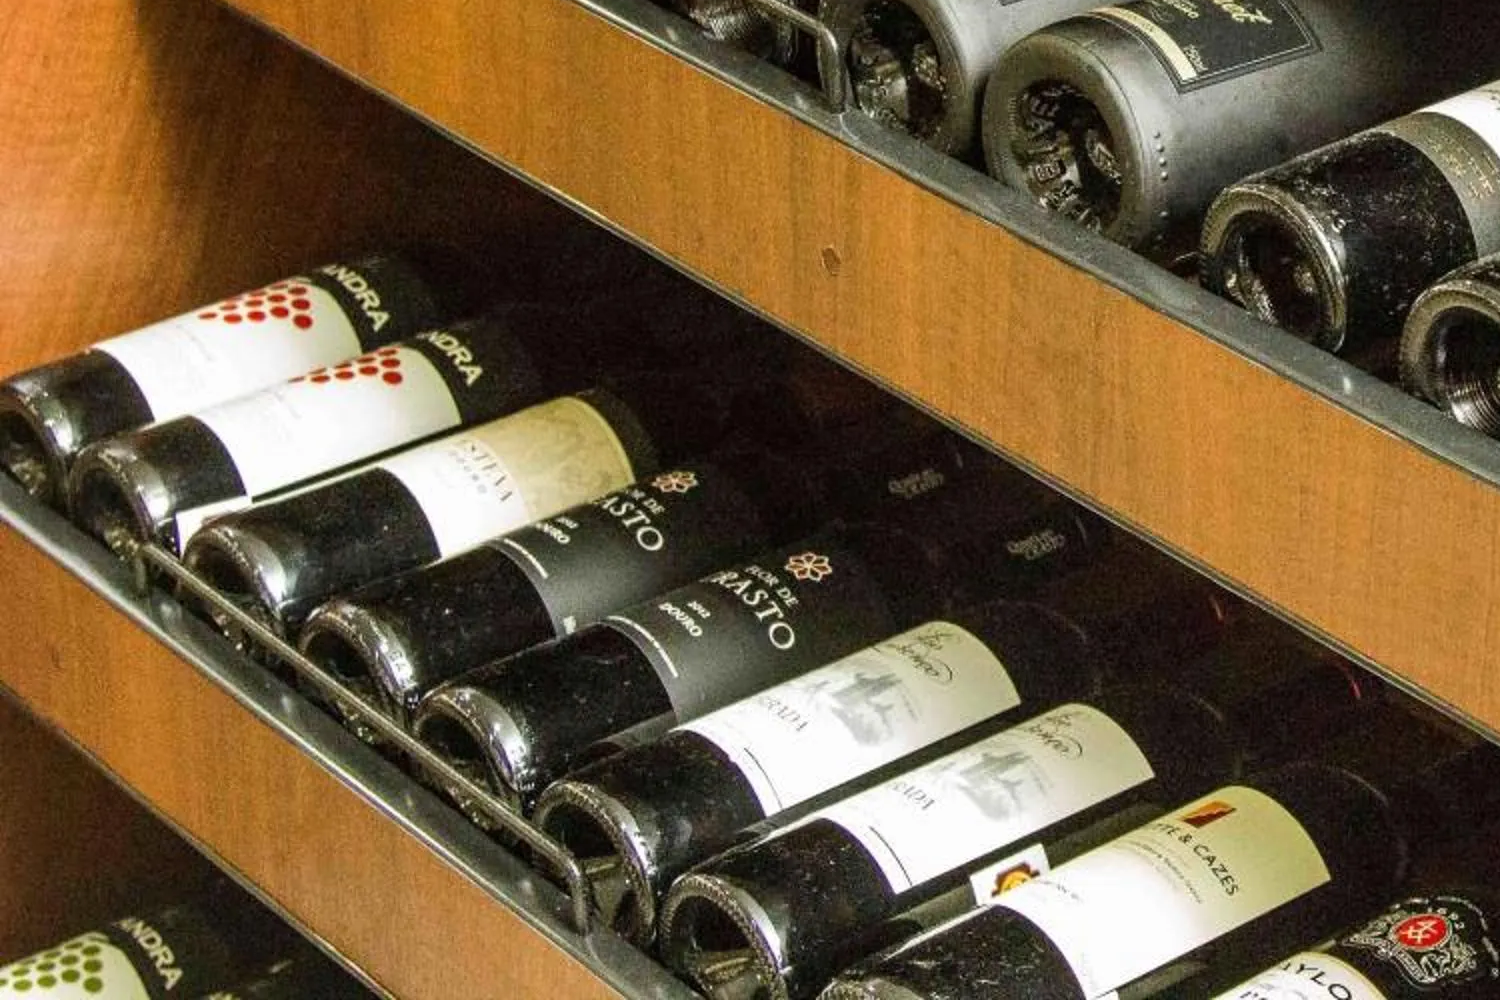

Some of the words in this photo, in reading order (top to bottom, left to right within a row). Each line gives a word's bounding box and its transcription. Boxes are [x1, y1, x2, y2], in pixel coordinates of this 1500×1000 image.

[600, 495, 665, 551] ASTO
[777, 585, 800, 609] DE
[1177, 831, 1194, 845] &
[1192, 843, 1240, 897] CAZES
